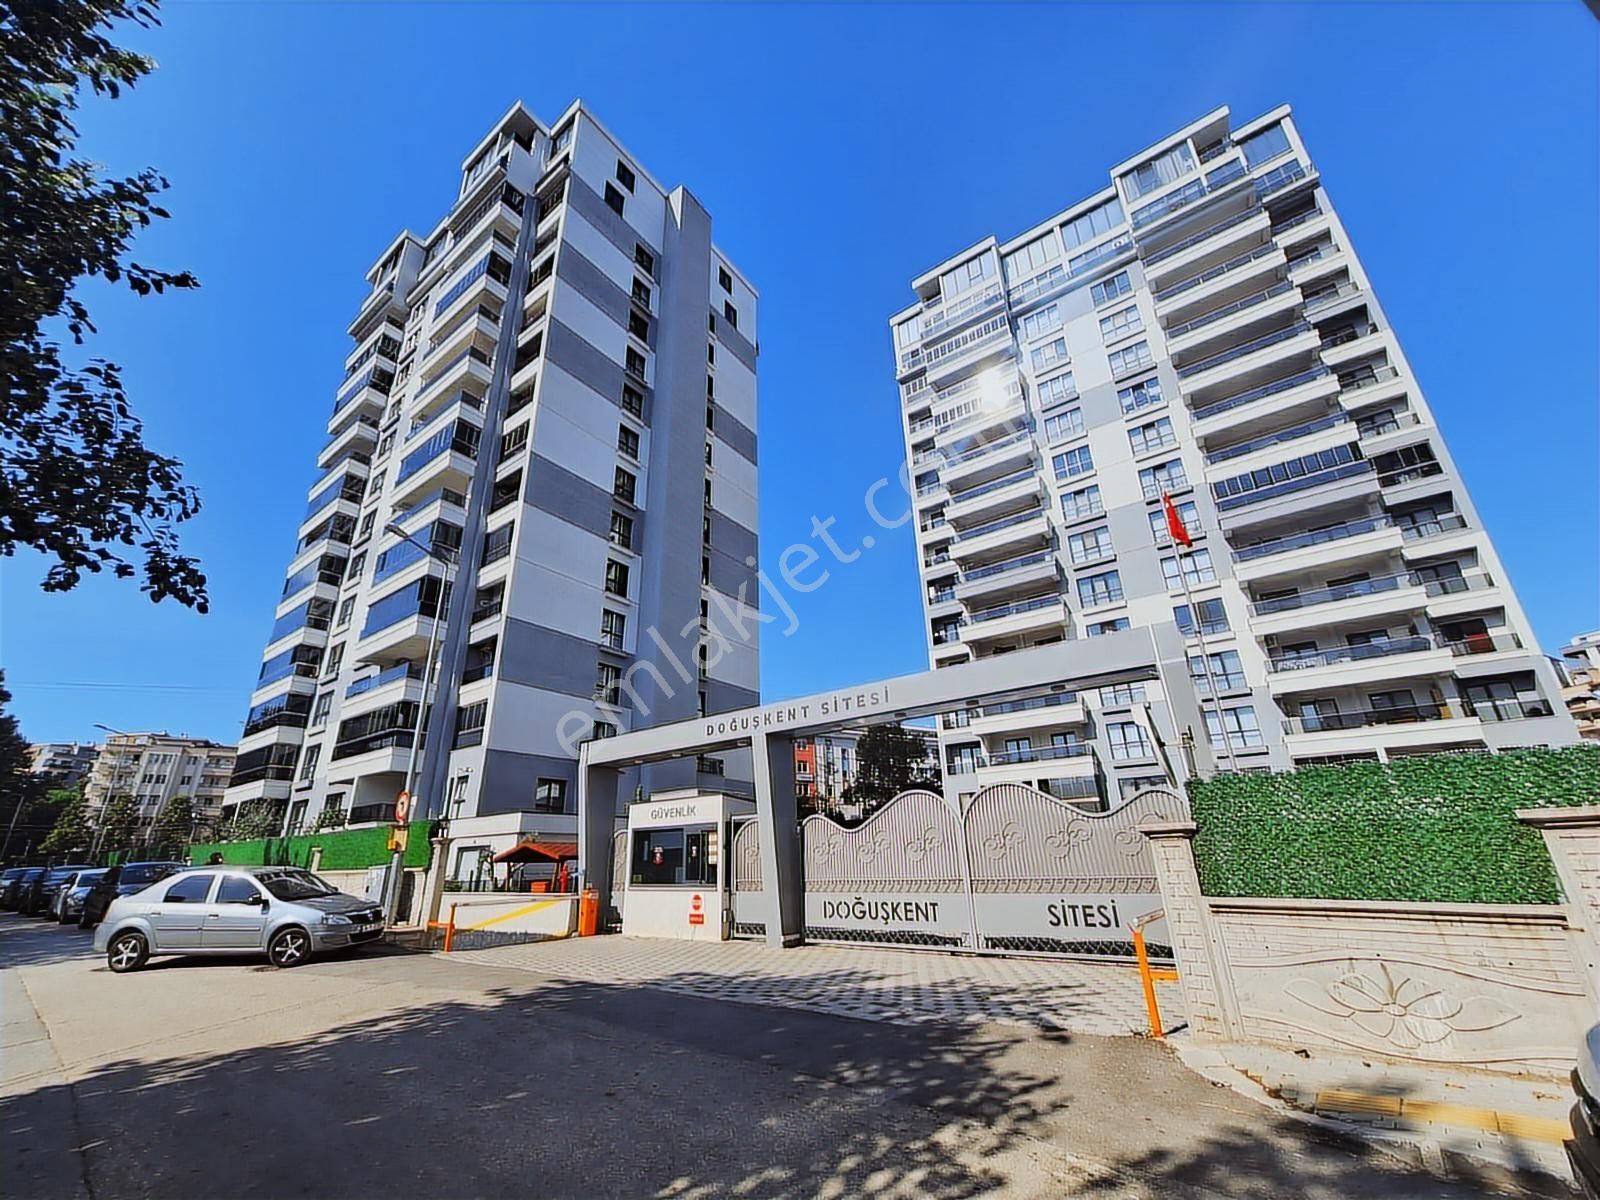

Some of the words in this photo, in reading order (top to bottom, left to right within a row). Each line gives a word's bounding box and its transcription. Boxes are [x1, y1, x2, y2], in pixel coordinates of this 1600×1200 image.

[706, 706, 809, 736] DOĞUŞKENT
[821, 686, 889, 715] SİTESİ
[651, 804, 696, 820] GÜVENLİK
[823, 896, 938, 925] DOĞUŞKENT
[1047, 899, 1120, 928] SİTESİ
